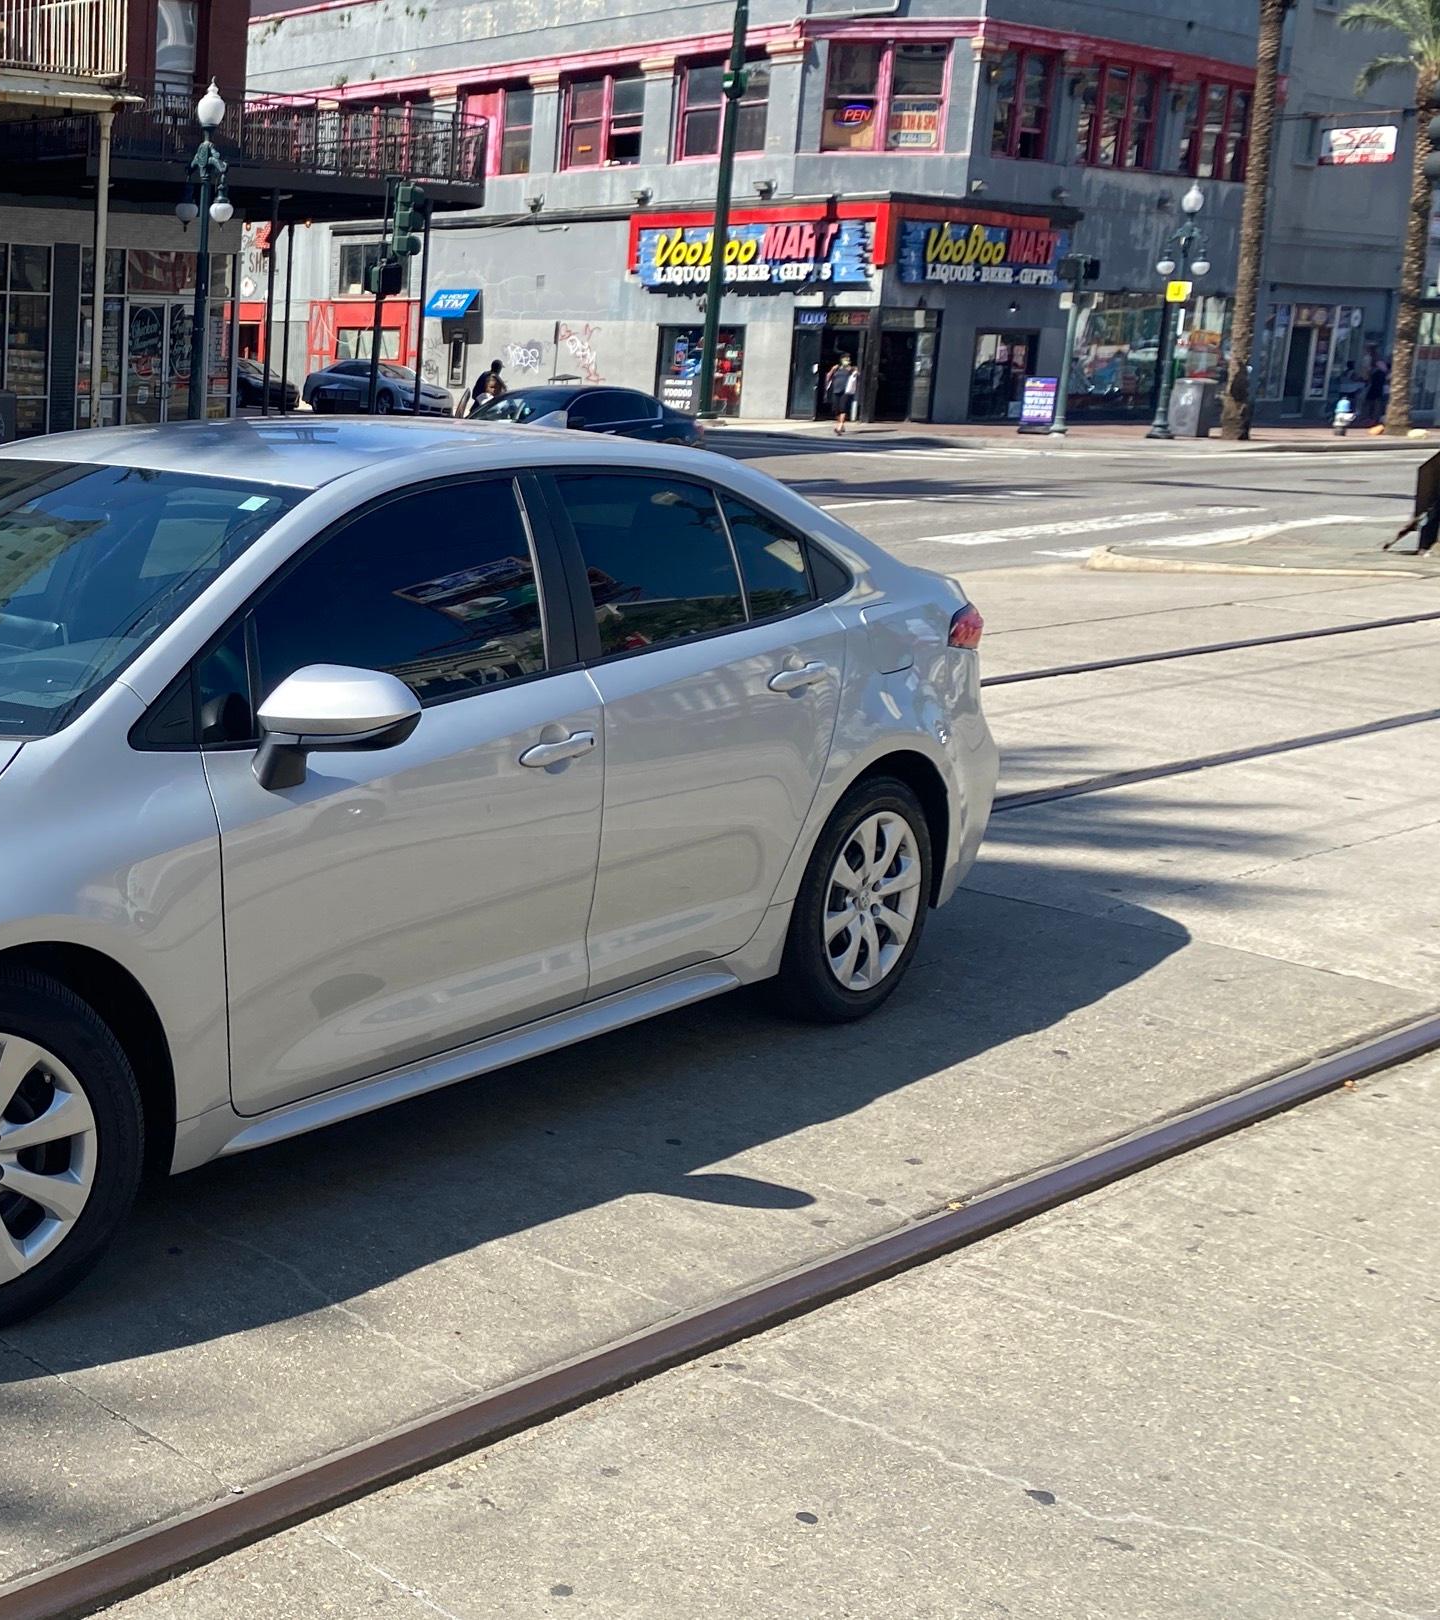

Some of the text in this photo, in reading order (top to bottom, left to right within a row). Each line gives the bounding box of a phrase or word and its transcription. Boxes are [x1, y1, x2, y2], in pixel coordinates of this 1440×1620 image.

[1342, 129, 1385, 146] Spa
[926, 221, 1060, 265] VooDoo MART
[725, 264, 771, 282] BEER
[926, 264, 1055, 285] LIQUOR BEER GIFTS
[432, 299, 466, 309] ATM
[800, 312, 827, 324] LIQUOR
[664, 387, 694, 398] VOODOO
